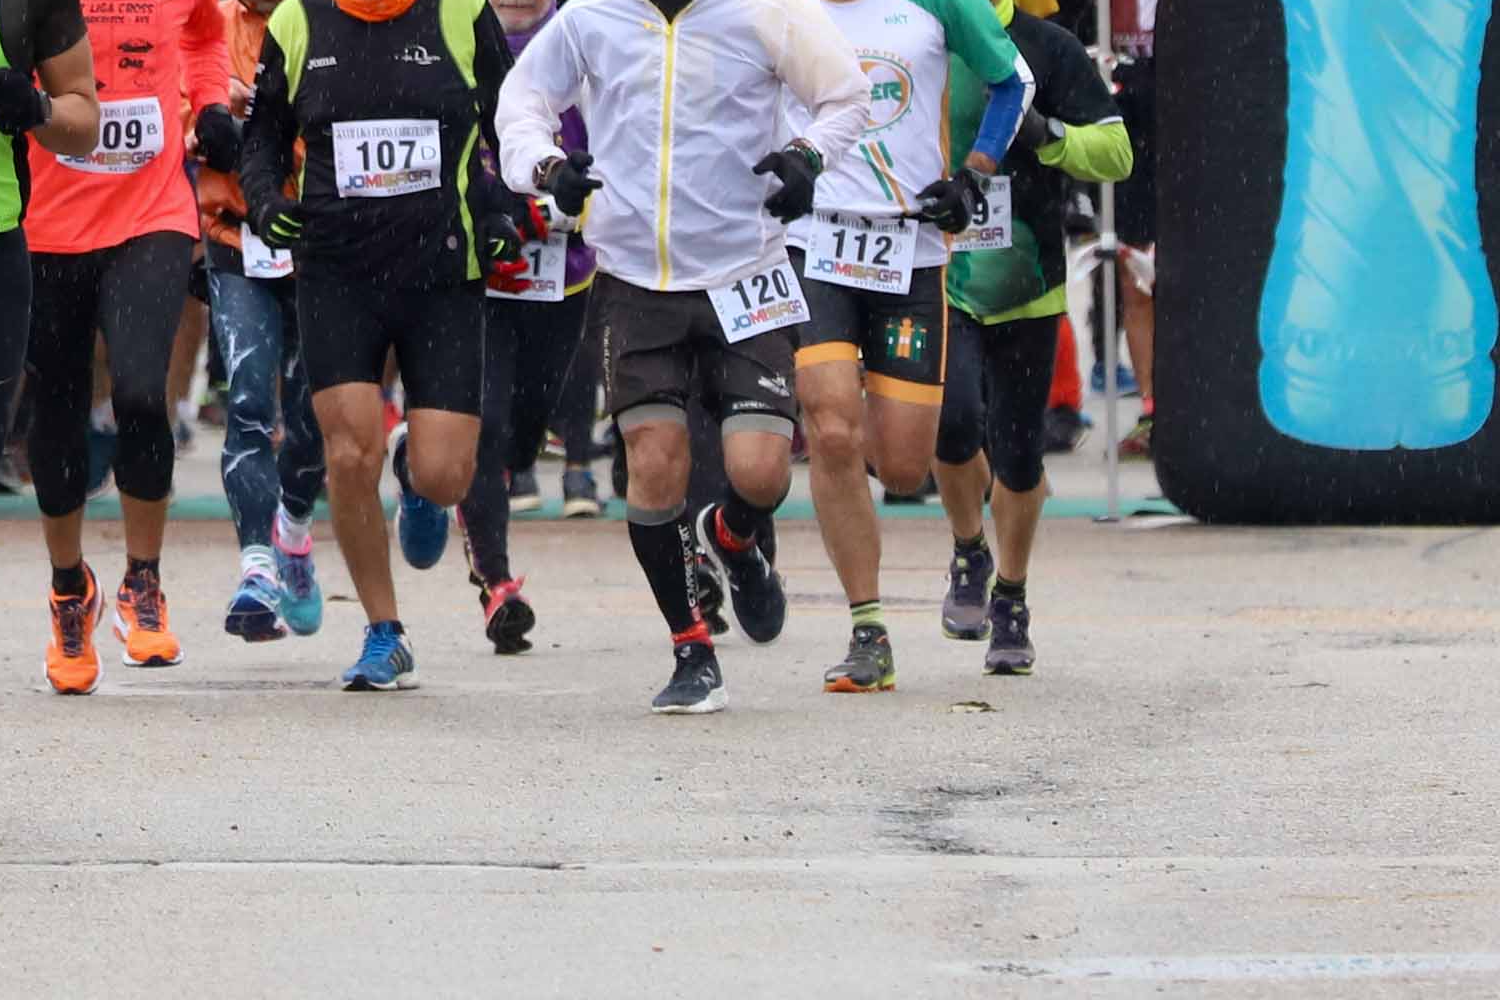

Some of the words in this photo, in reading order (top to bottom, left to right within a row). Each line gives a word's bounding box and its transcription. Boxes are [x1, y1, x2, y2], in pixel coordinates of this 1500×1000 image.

[102, 119, 143, 150] 09
[355, 139, 417, 171] 107
[832, 229, 894, 266] 112
[731, 268, 790, 312] 120
